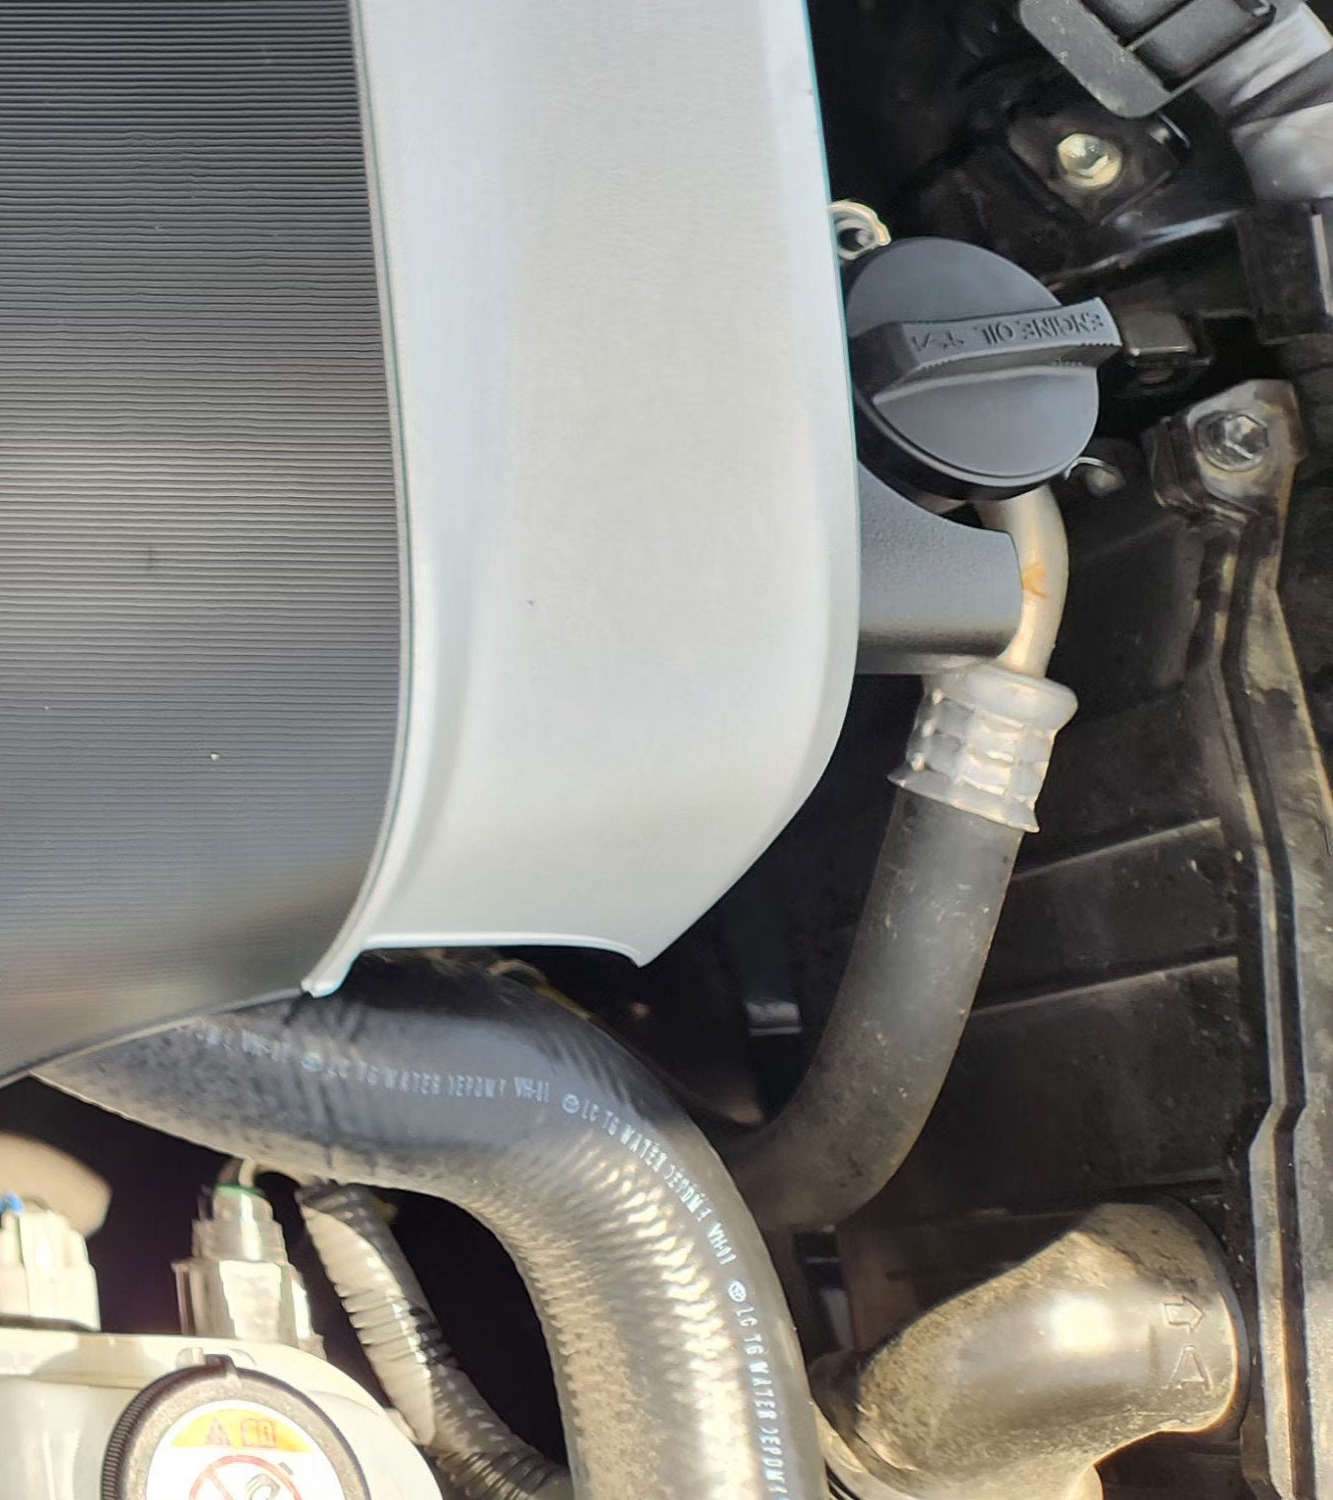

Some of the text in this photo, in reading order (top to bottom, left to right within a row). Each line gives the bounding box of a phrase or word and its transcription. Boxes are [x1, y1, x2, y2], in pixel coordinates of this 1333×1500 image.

[973, 311, 1105, 347] ENGINE OIL
[619, 1123, 668, 1174] WATER
[749, 1361, 778, 1420] WATER
